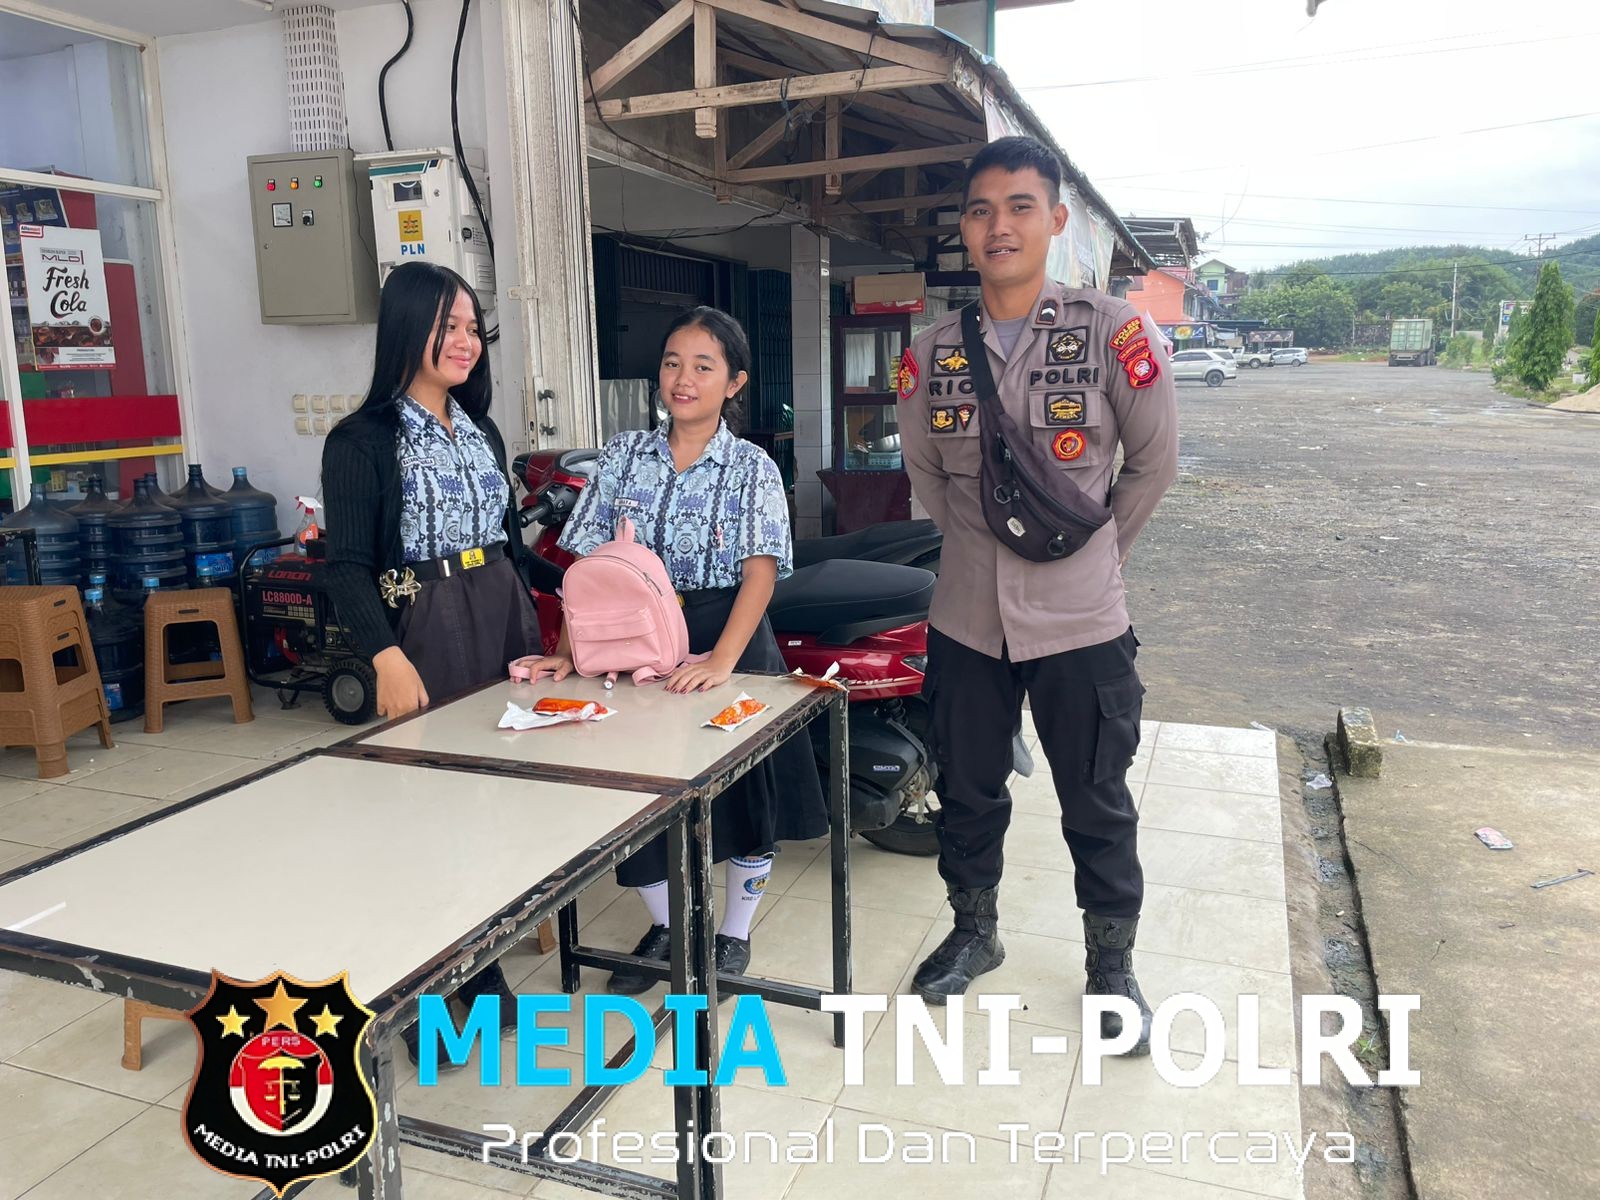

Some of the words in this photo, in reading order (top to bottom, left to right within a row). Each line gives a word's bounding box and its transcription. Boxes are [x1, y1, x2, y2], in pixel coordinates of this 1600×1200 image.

[400, 243, 425, 255] PLN
[42, 266, 89, 292] Fresh
[50, 290, 87, 319] Cola
[1113, 319, 1141, 347] POLRES
[1030, 367, 1099, 386] POLRI
[928, 379, 976, 397] RIO
[261, 590, 313, 606] LC8800D-A
